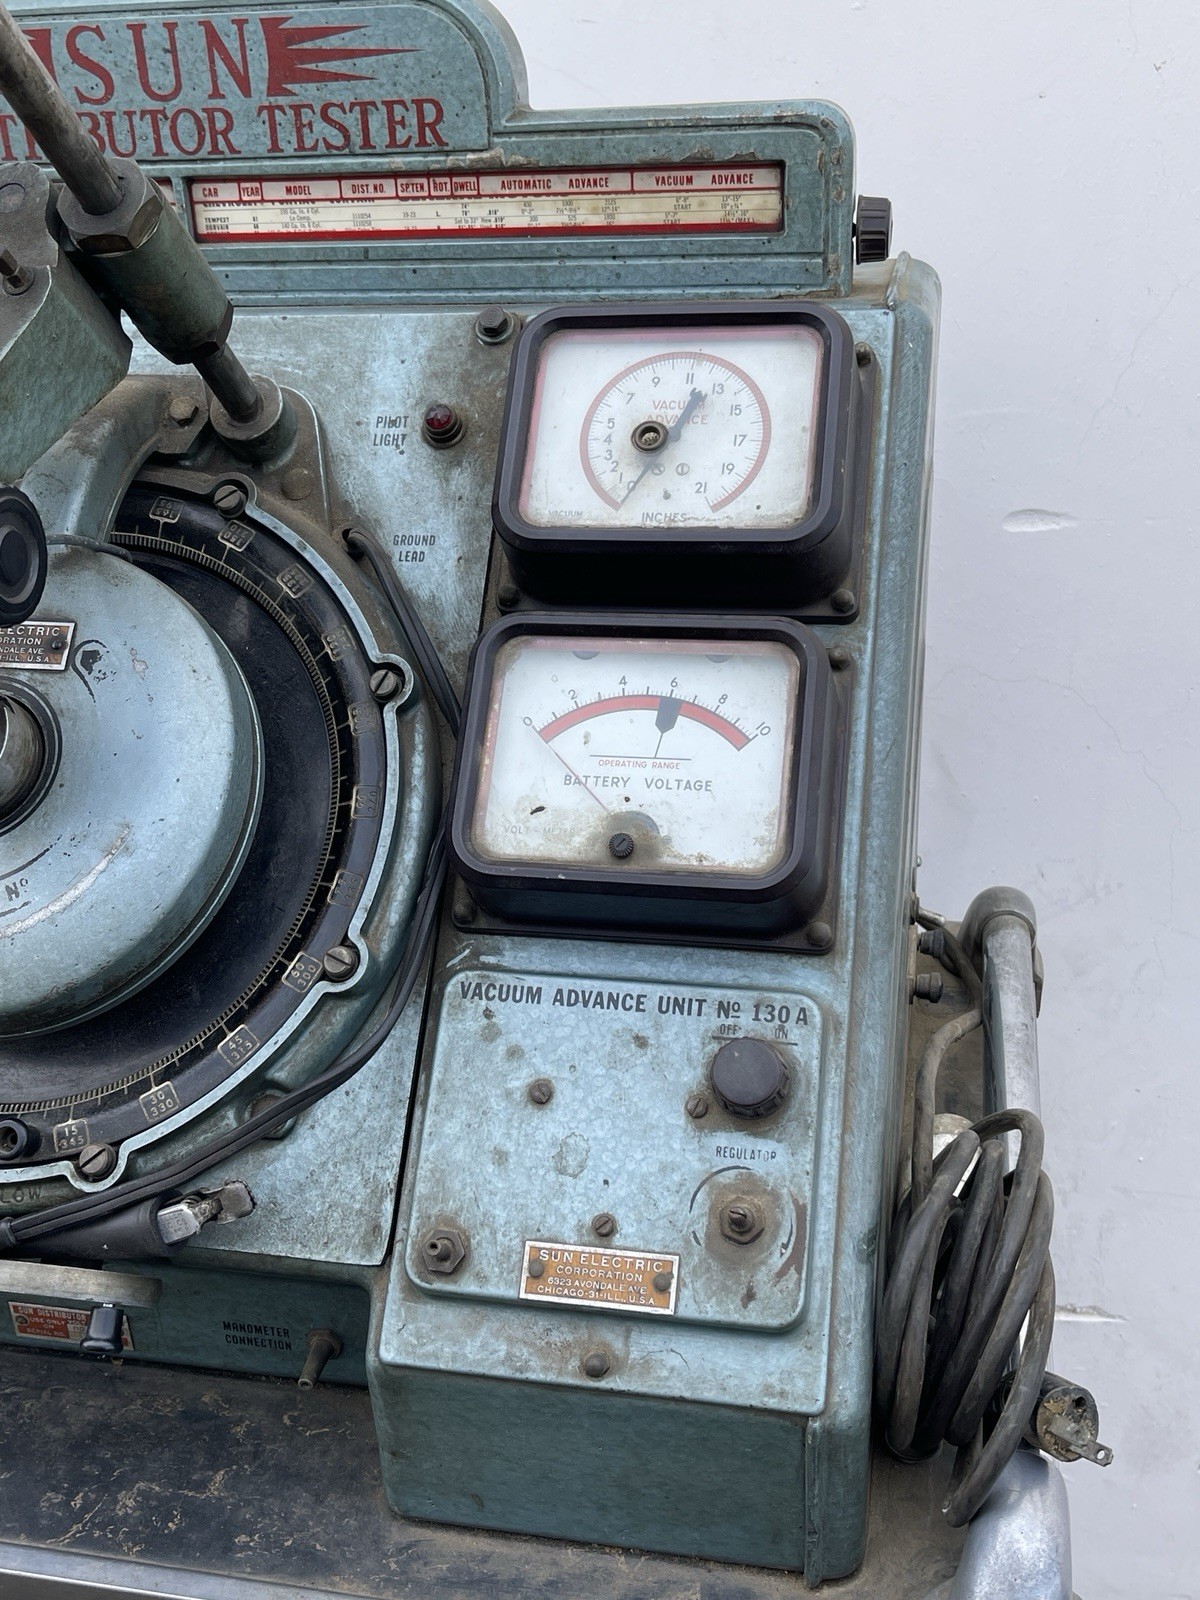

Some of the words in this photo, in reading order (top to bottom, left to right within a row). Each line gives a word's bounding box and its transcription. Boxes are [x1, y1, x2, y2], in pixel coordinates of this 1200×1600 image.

[65, 18, 250, 104] SUN
[0, 107, 242, 161] TBUTOR
[257, 98, 449, 153] TESTER
[501, 178, 552, 191] AUTOMATIC
[569, 176, 610, 189] ADVANCE
[655, 175, 694, 186] VACUUM
[711, 173, 754, 185] ADVANCE
[202, 187, 219, 198] CAR
[242, 186, 260, 198] YEAR
[285, 185, 312, 196] MODEL
[351, 184, 372, 195] DIST.
[373, 183, 387, 194] NO.
[433, 180, 450, 192] ROT.
[454, 179, 478, 192] DWELL
[652, 376, 660, 388] 9
[686, 373, 694, 385] 11
[712, 382, 724, 395] 13
[626, 392, 635, 404] 7
[653, 400, 705, 410] VACUM
[730, 404, 742, 416] 15
[376, 416, 409, 428] PILOT
[607, 418, 615, 429] 5
[373, 433, 408, 447] LIGHT
[603, 434, 613, 445] 4
[733, 434, 747, 447] 17
[605, 449, 613, 460] 3
[610, 461, 619, 472] 2
[721, 463, 735, 475] 19
[618, 473, 623, 484] 1
[627, 480, 636, 491] 0
[695, 482, 707, 494] 21
[548, 510, 583, 518] VACUUM
[641, 512, 687, 523] INCHES
[393, 535, 436, 546] GROUND
[398, 551, 425, 562] LEAD
[619, 675, 627, 686] 4
[671, 677, 678, 688] 6
[569, 689, 577, 700] 2
[718, 693, 728, 705] 8
[523, 716, 533, 727] 0
[756, 721, 771, 737] 10
[598, 759, 647, 769] OPERATING
[651, 761, 680, 770] RANGE
[564, 774, 631, 788] BATTERY
[644, 777, 713, 792] VOLTAGE
[460, 981, 543, 1005] VACUUM
[552, 988, 647, 1014] ADVANCE
[658, 996, 707, 1017] UNIT
[720, 1023, 738, 1035] OFF
[774, 1028, 788, 1039] ON
[715, 1146, 777, 1161] REGULATOR
[539, 1249, 573, 1264] SUN
[580, 1253, 663, 1272] ELECTRIC
[556, 1265, 643, 1282] CORPORATION
[547, 1276, 572, 1286] 6323
[574, 1280, 625, 1292] AVONDALE
[18, 1306, 34, 1315] SUN
[38, 1309, 87, 1321] DISTRIBUTOR
[47, 1318, 65, 1326] ONLY
[27, 1328, 52, 1336] SERIAL
[223, 1320, 291, 1338] MANOMETER
[225, 1333, 292, 1350] CONNECTION
